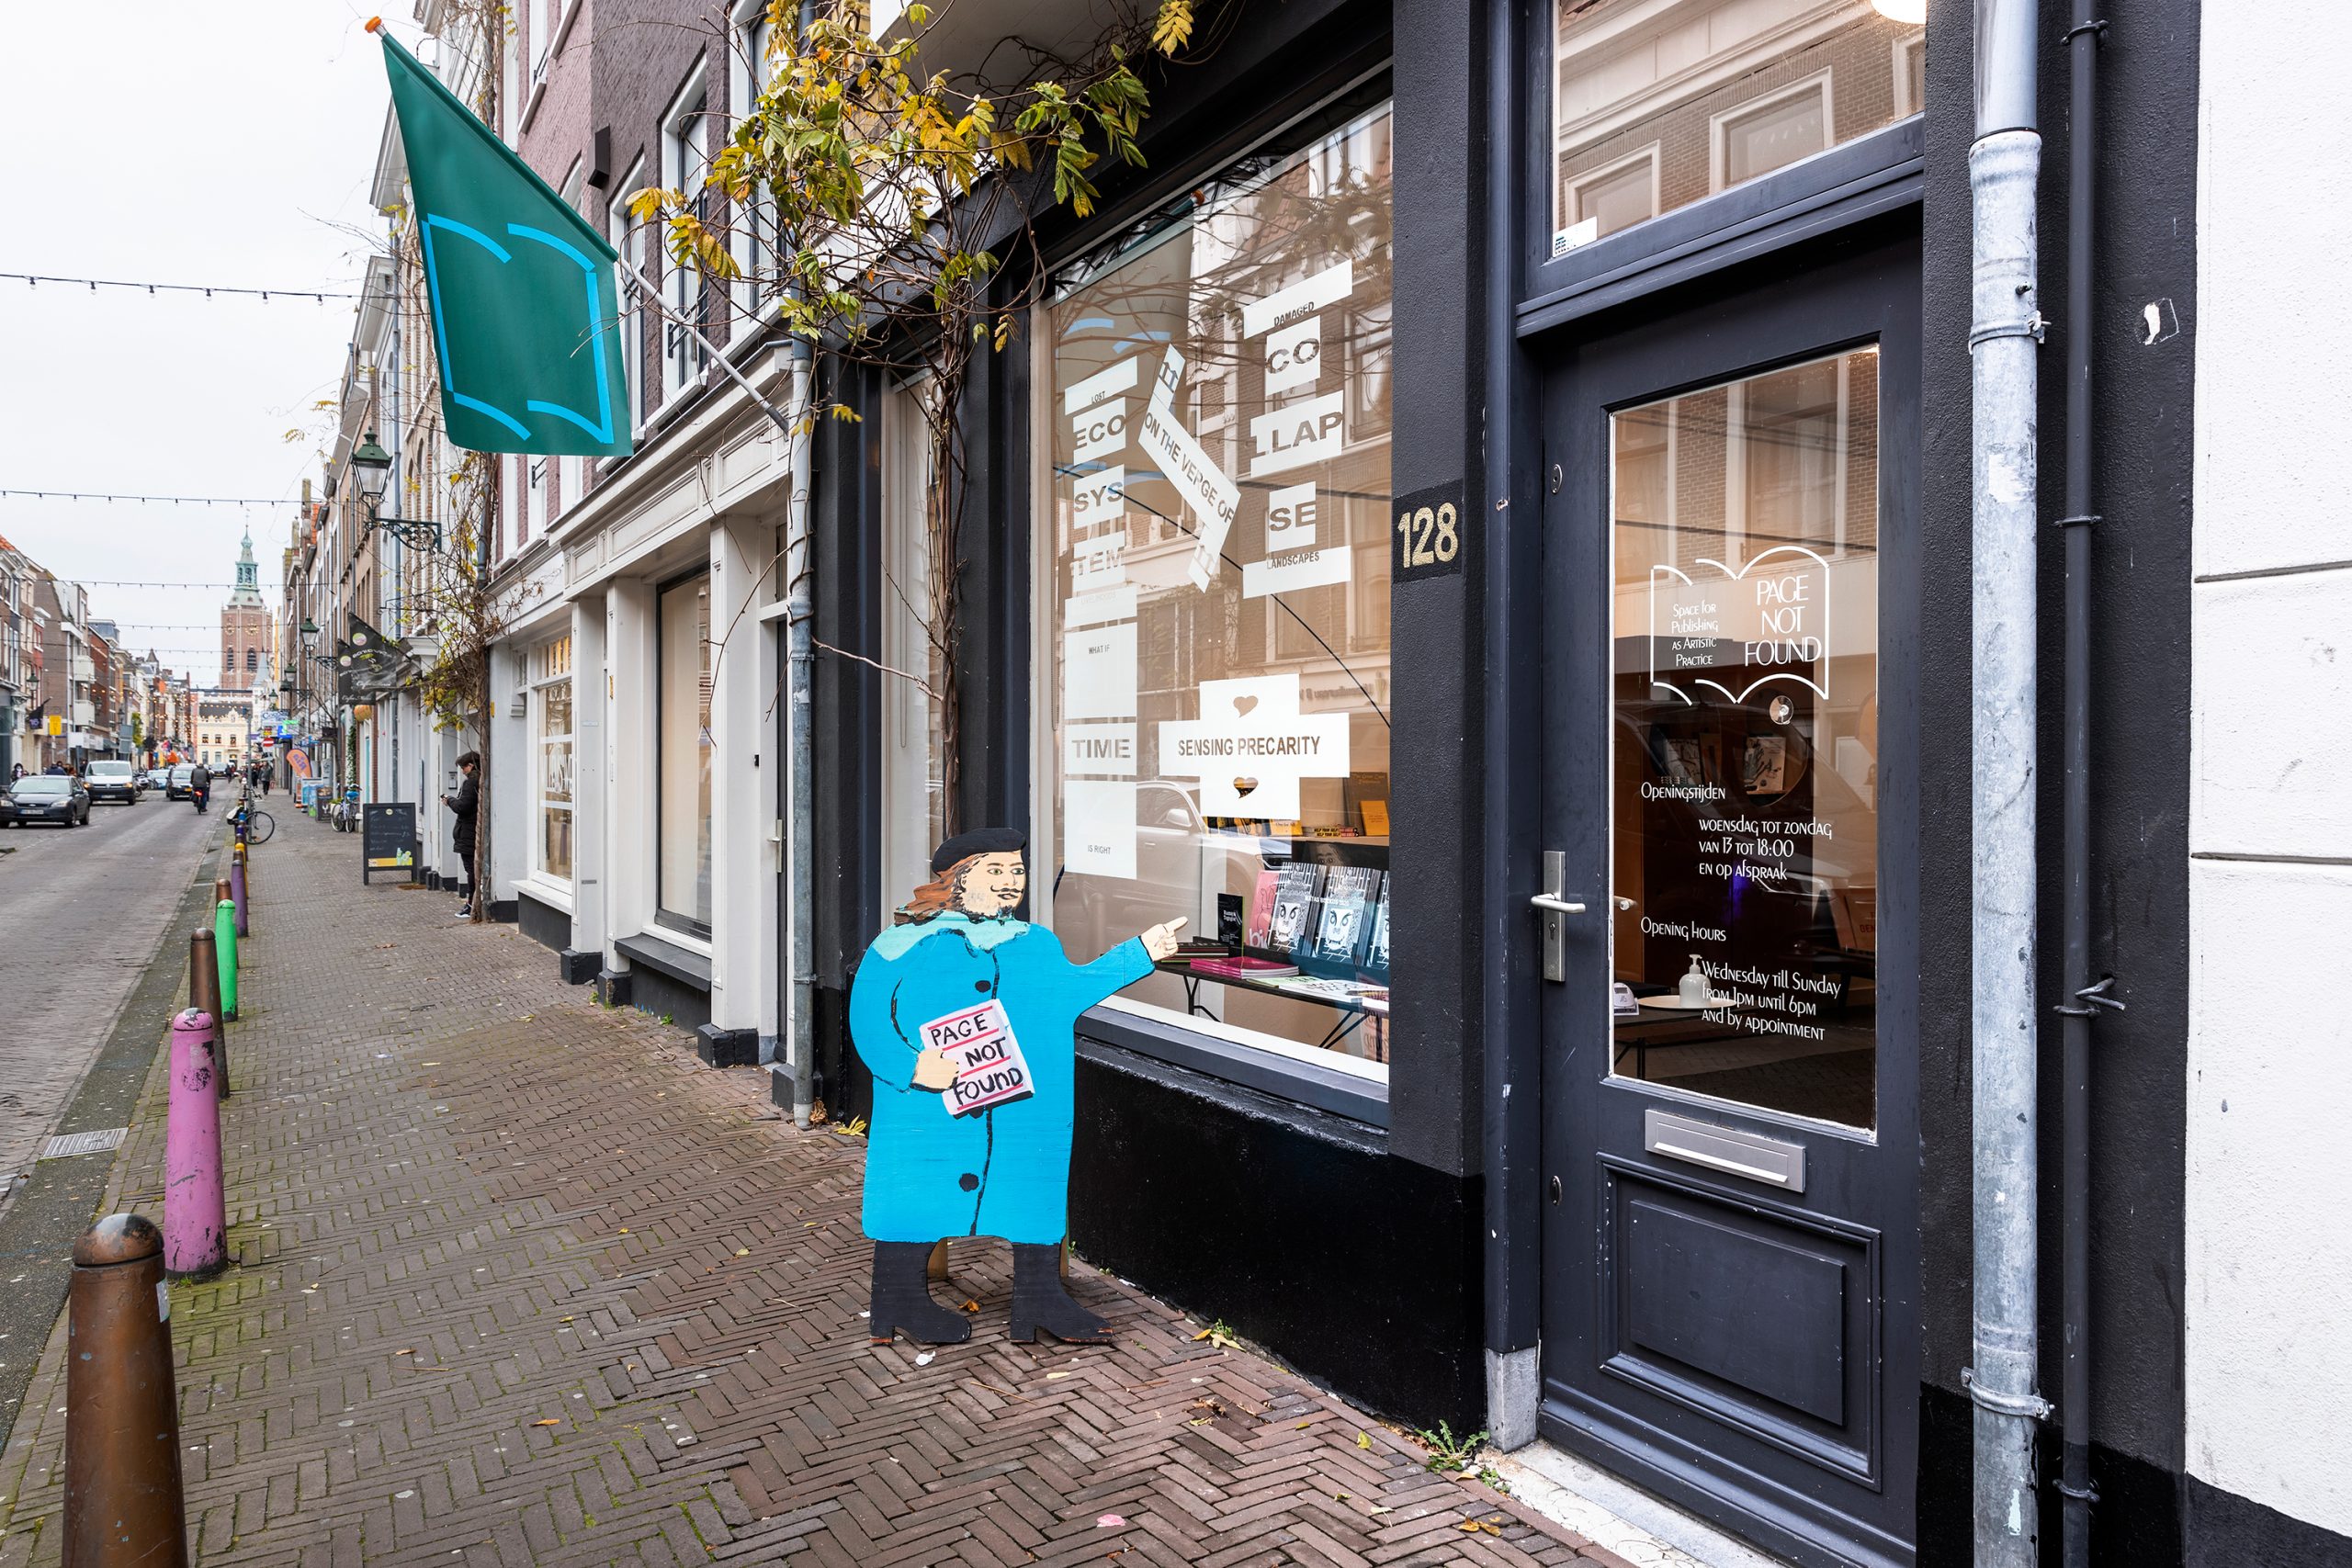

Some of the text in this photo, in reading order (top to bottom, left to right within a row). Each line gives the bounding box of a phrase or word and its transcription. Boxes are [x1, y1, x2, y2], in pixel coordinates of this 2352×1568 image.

[1273, 301, 1315, 326] DAMAGED
[1266, 338, 1320, 374] CO
[1091, 391, 1105, 404] LOST
[1075, 414, 1126, 448] ECO
[1144, 412, 1235, 524] ON THE VERGE OF
[1074, 481, 1124, 513] SYS
[1270, 501, 1316, 531] SE
[1397, 502, 1458, 568] 128
[1072, 547, 1125, 576] TEM
[1267, 552, 1319, 570] LANDSCAPES
[1757, 575, 1809, 605] PAGE
[1701, 600, 1716, 614] for
[1761, 606, 1806, 635] NOT
[1671, 617, 1719, 634] Publishing
[1088, 644, 1110, 654] WHAT IF
[1676, 653, 1713, 667] Practice
[1745, 637, 1822, 667] FOUND
[1071, 739, 1131, 758] TIME
[1178, 736, 1320, 756] SENSING PRECARITY
[1641, 782, 1725, 803] Openingstijden
[1094, 845, 1111, 854] RIGHT
[1723, 837, 1733, 854] 13
[1758, 839, 1794, 857] 18:00
[1641, 917, 1689, 941] Opening
[1702, 961, 1770, 989] Wednesday
[1792, 972, 1841, 998] Sunday
[931, 1013, 988, 1046] PAGE
[966, 1036, 1006, 1066] NOT
